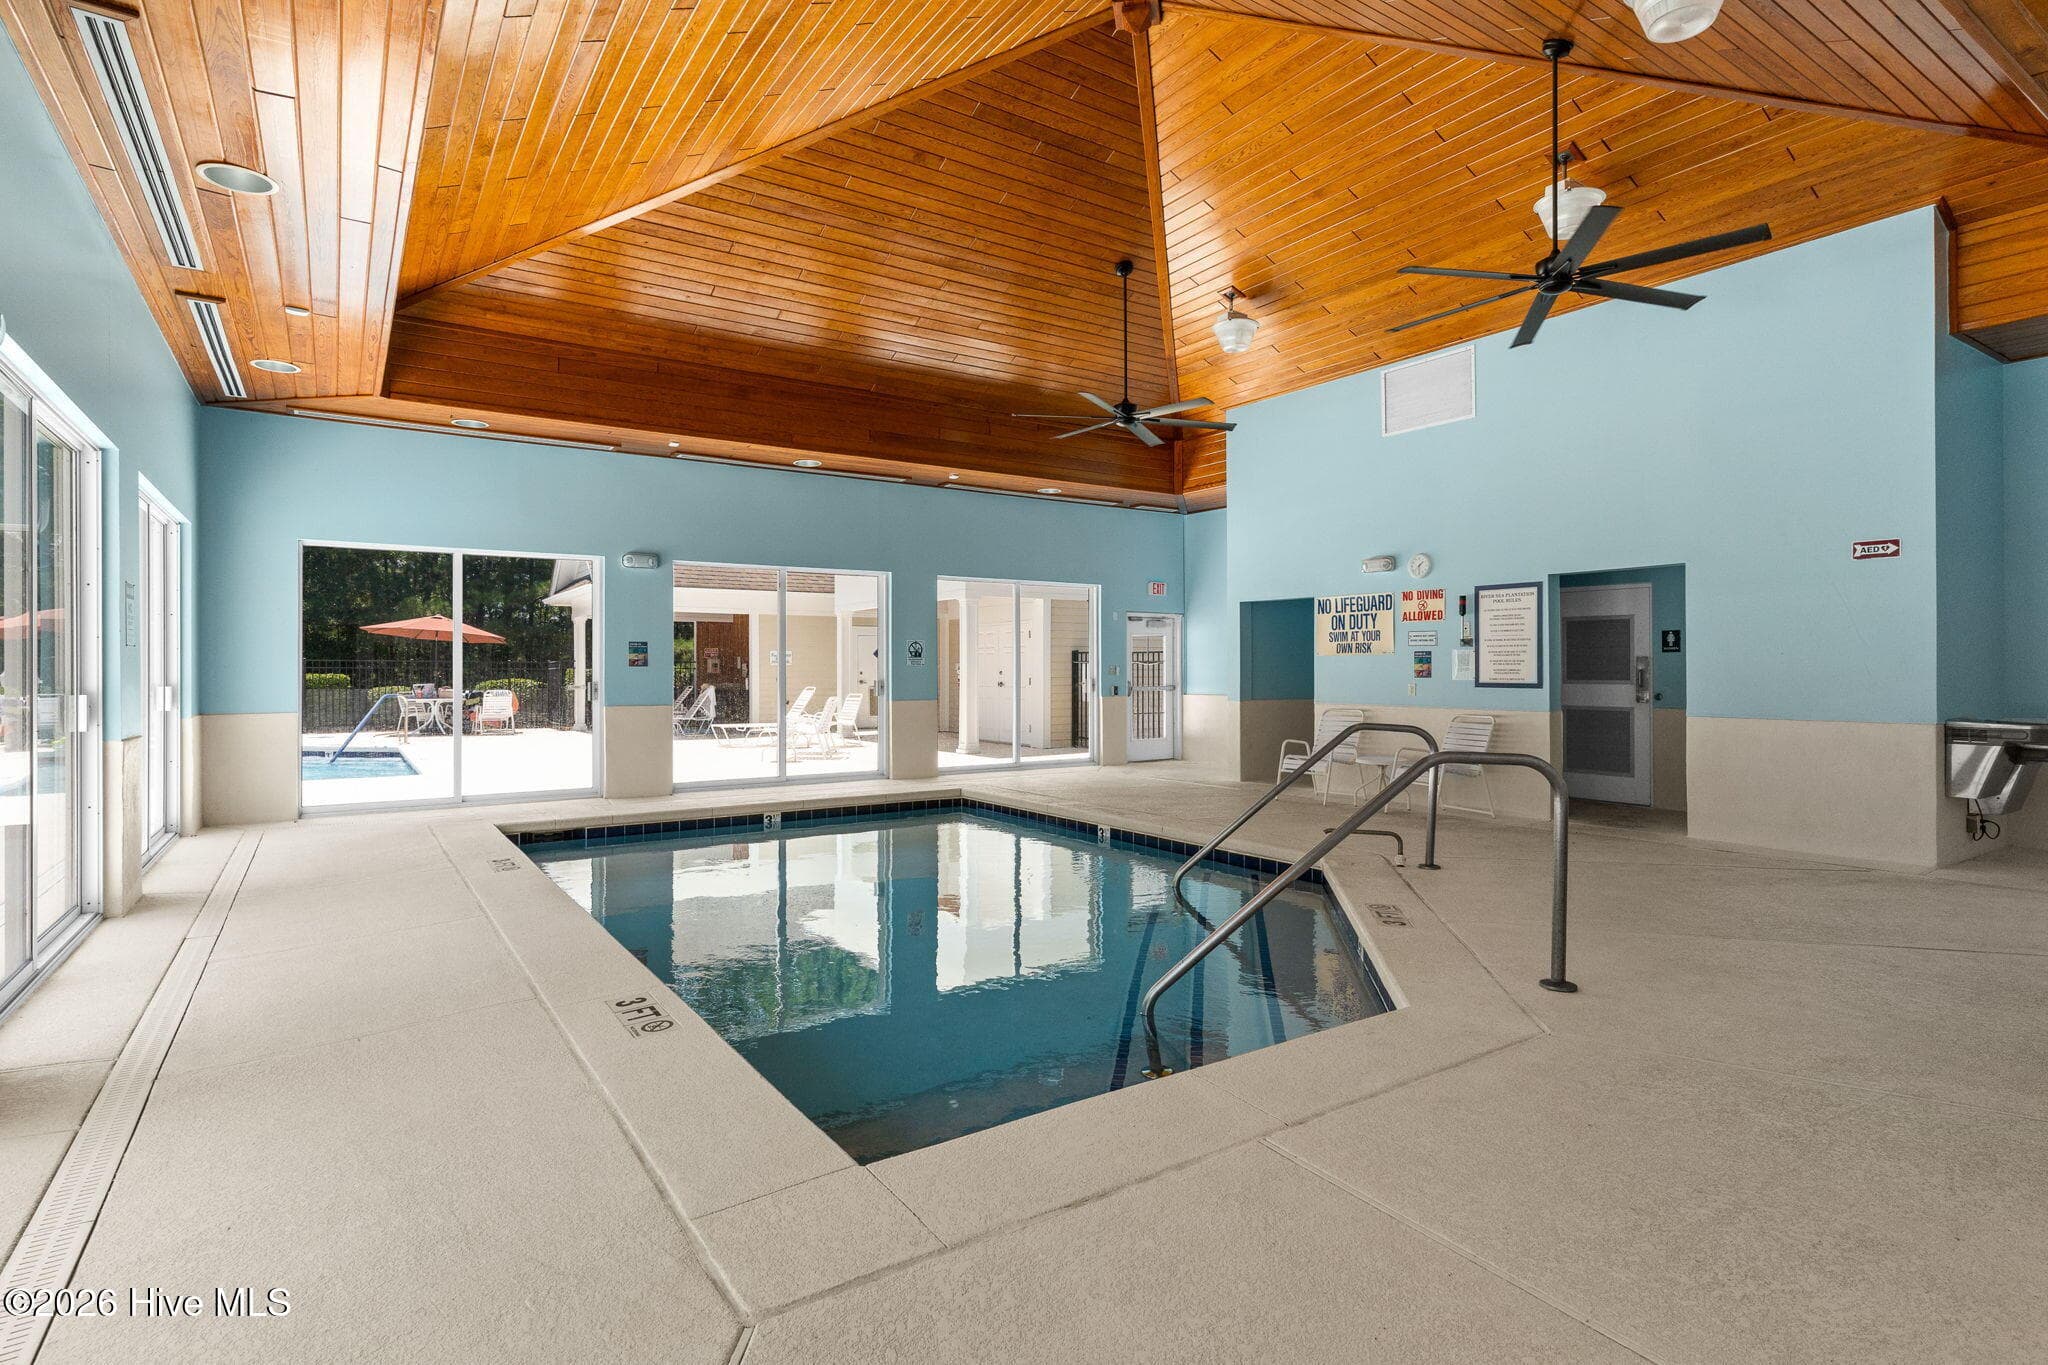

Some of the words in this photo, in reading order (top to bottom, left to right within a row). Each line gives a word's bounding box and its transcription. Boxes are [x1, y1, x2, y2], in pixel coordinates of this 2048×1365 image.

[1860, 545, 1880, 553] AED
[1152, 582, 1165, 595] EXIT
[1402, 591, 1413, 601] NO
[1417, 589, 1444, 600] DIVING
[1317, 598, 1332, 615] NO
[1335, 594, 1393, 613] LIFEGUARD
[1331, 614, 1345, 630] ON
[1349, 613, 1378, 630] DUTY
[1402, 610, 1443, 621] ALLOWED
[1328, 631, 1348, 642] SWIM
[1350, 631, 1359, 642] AT
[1362, 630, 1381, 641] YOUR
[1336, 643, 1353, 654] OWN
[1355, 642, 1372, 653] RISK
